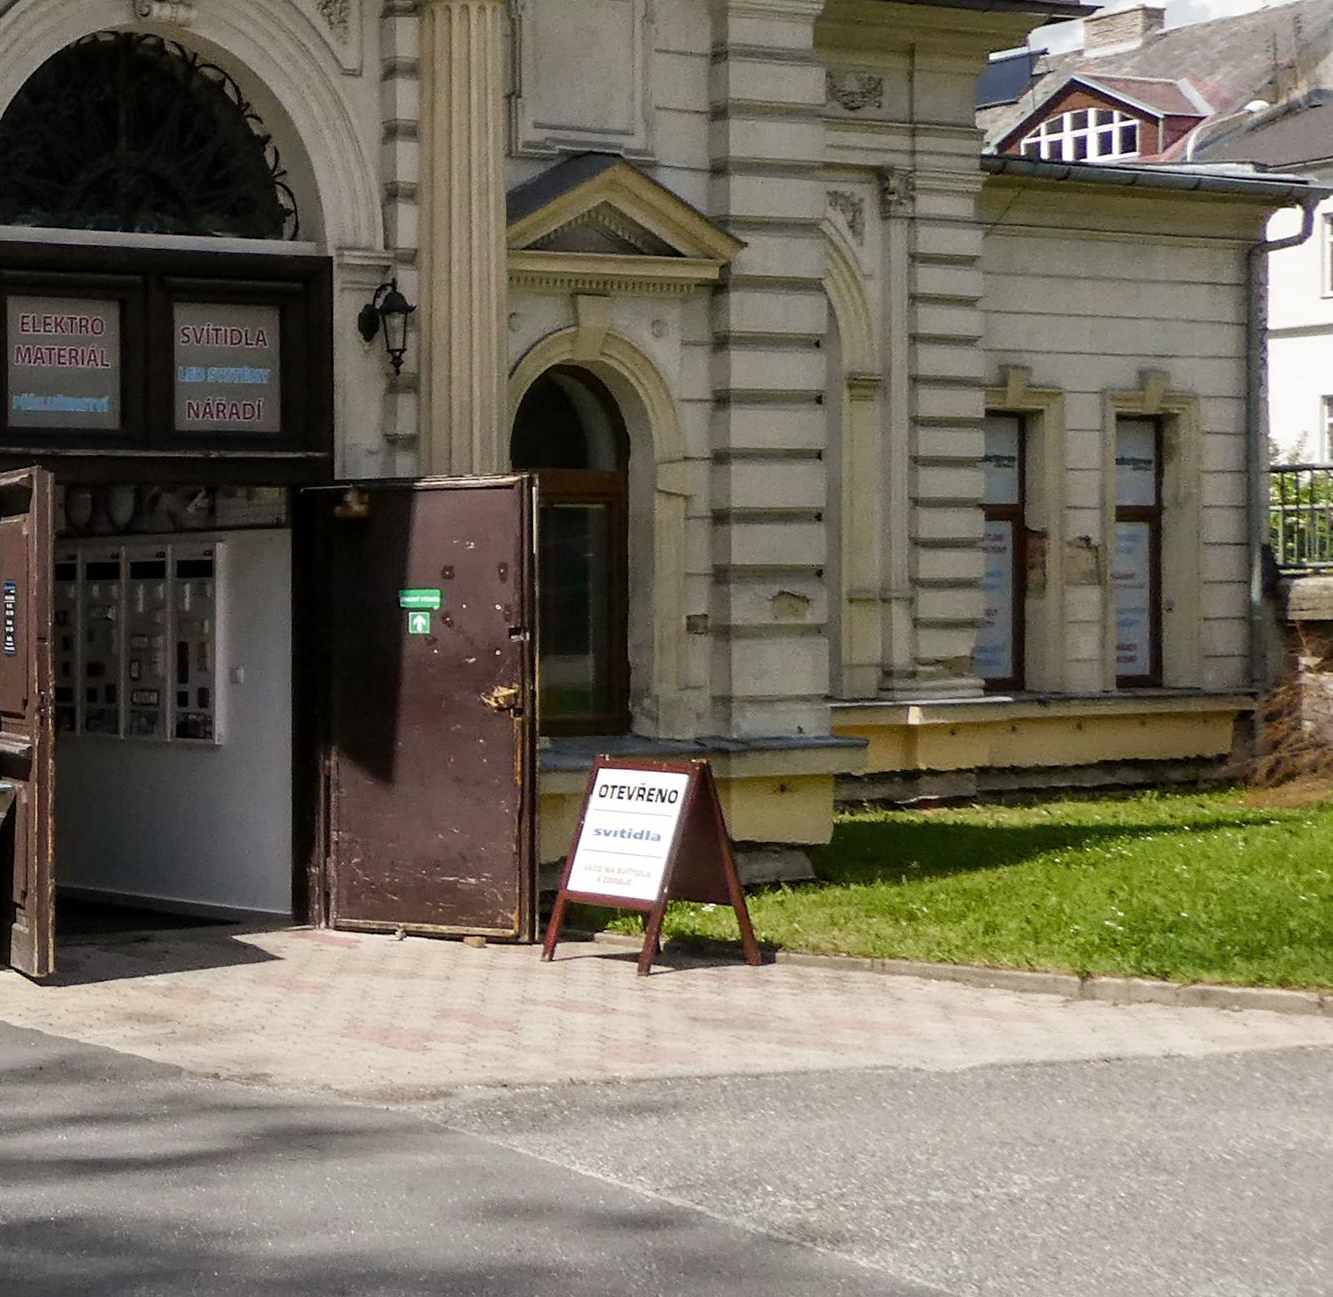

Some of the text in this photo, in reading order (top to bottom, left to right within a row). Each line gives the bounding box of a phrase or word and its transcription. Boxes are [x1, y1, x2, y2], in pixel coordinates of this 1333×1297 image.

[19, 314, 105, 336] ELEKTRO
[180, 323, 269, 348] SVÍTIDLA
[14, 344, 111, 369] MATERIÁL
[186, 397, 263, 422] NÁŘADÍ
[598, 783, 679, 804] OTEVŘENO
